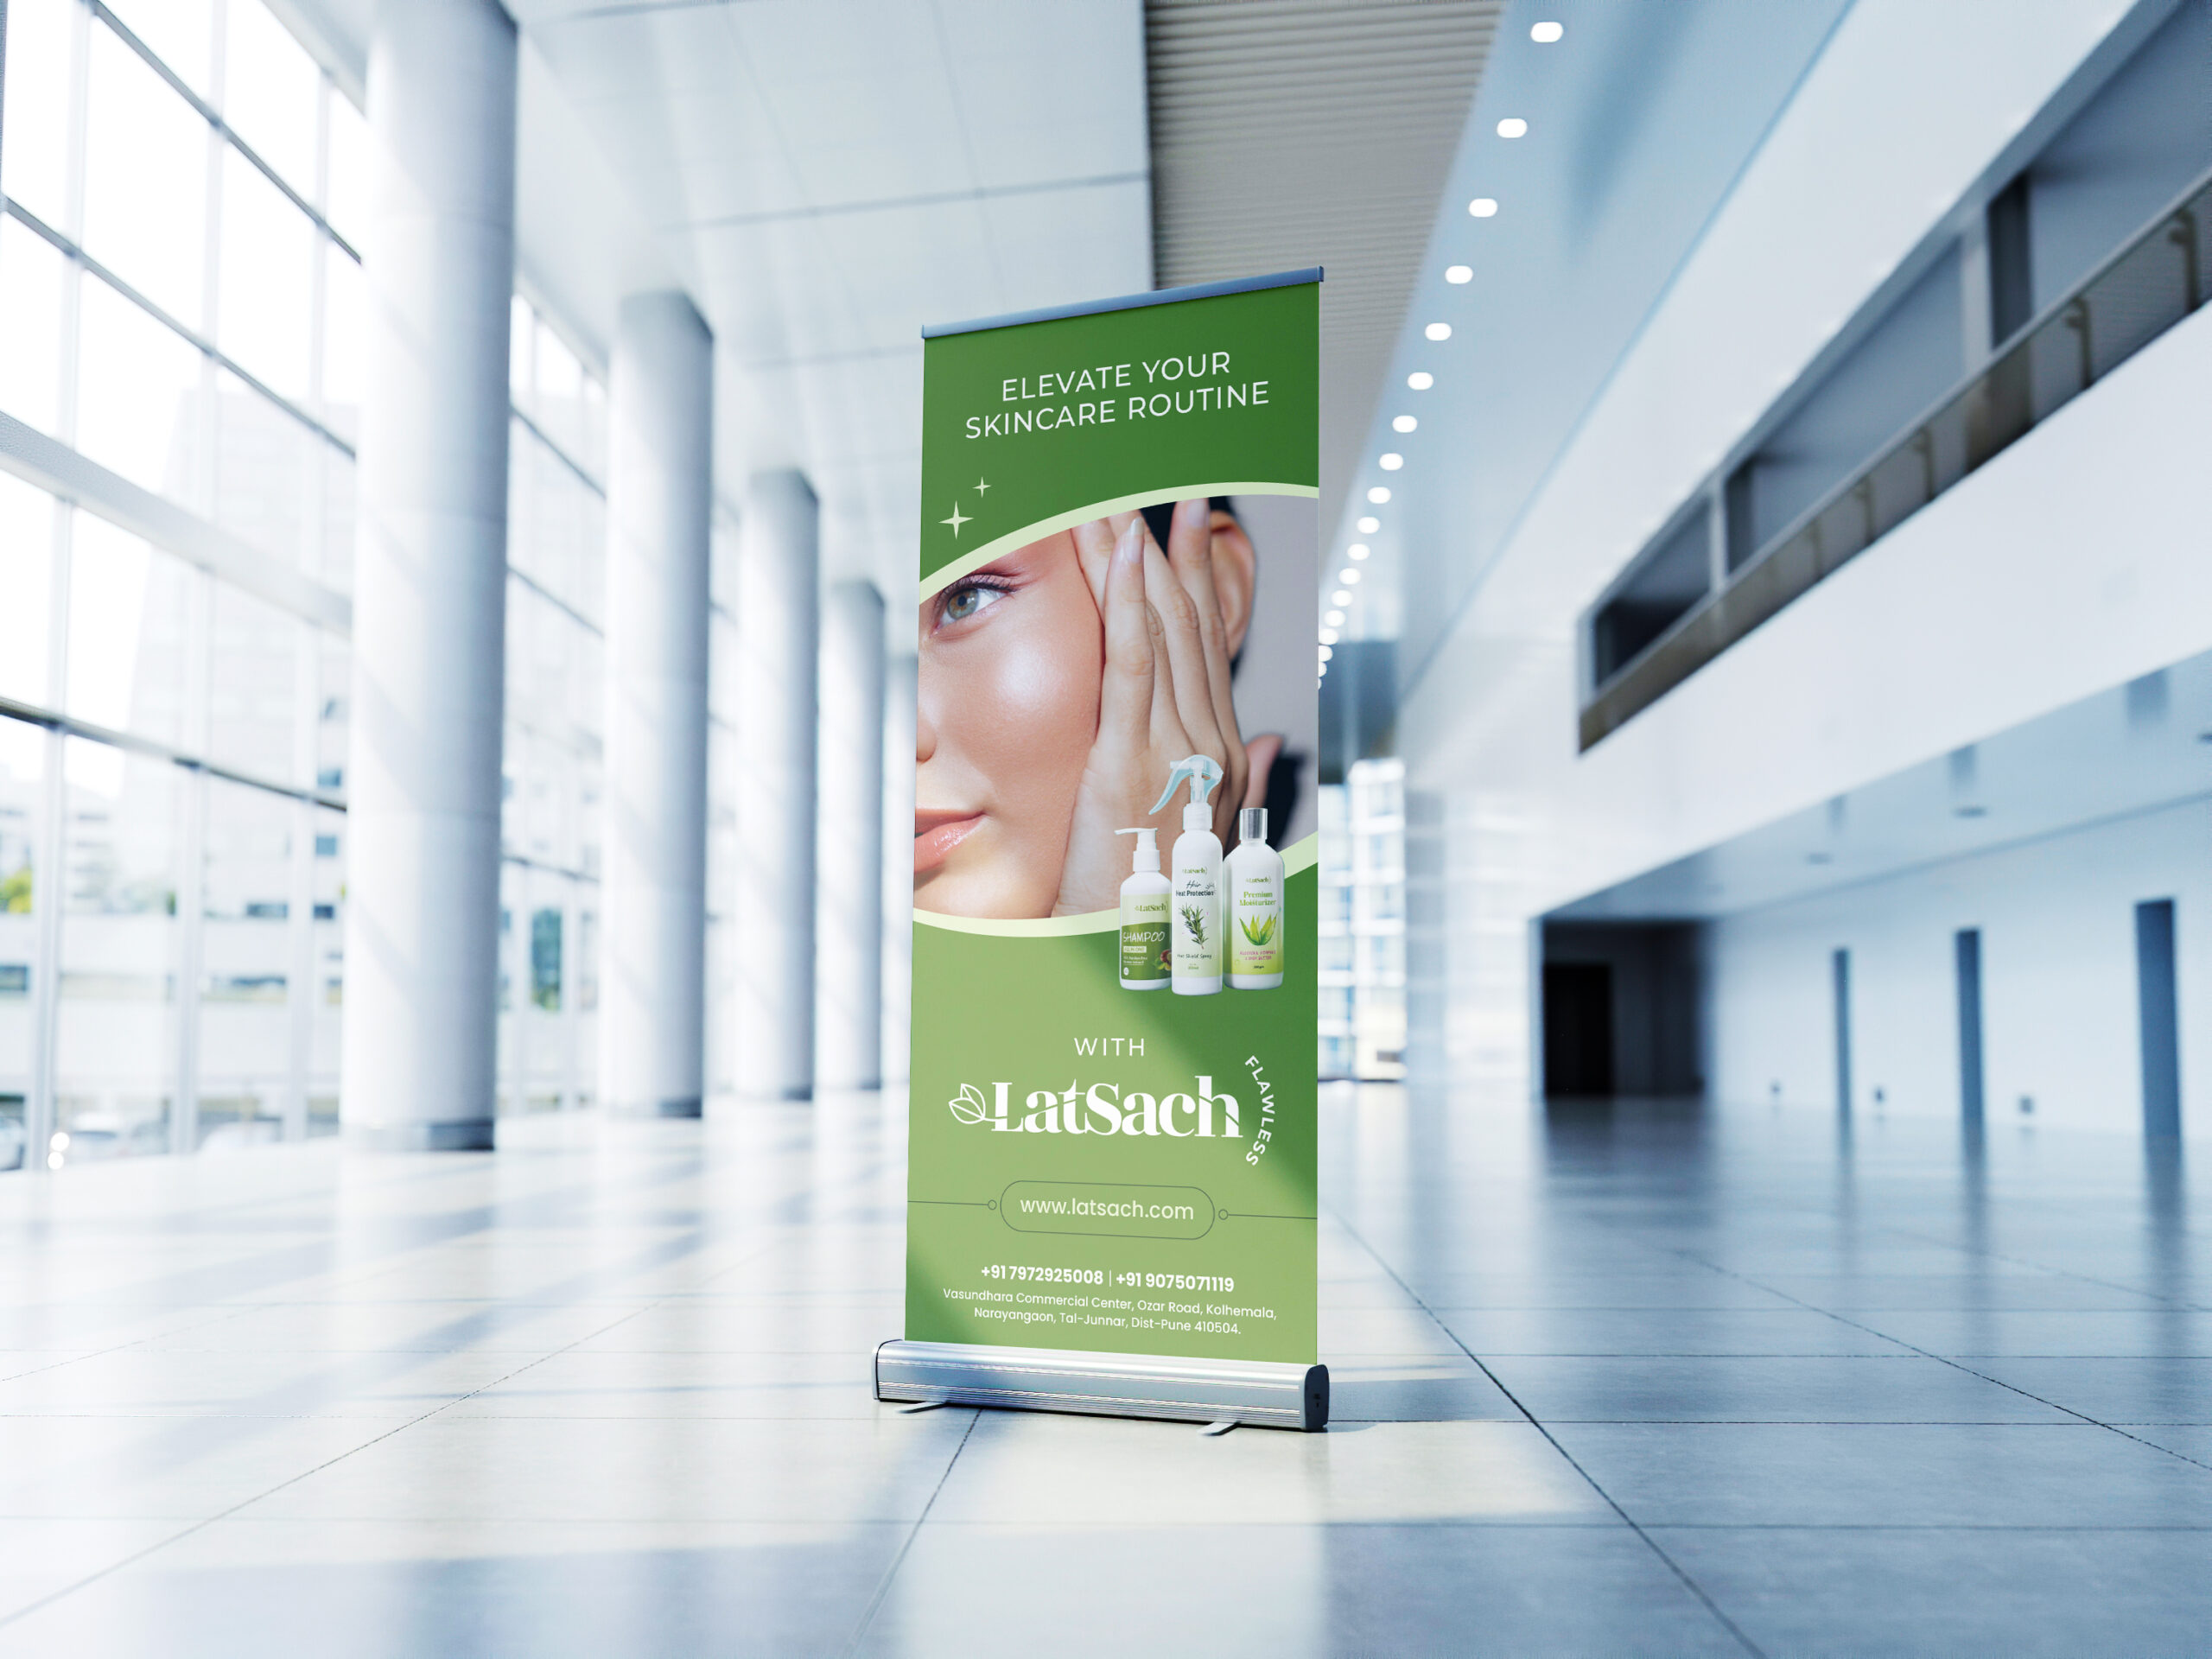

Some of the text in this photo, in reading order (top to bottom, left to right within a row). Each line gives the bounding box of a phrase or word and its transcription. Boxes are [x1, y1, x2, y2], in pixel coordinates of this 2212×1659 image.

[1002, 351, 1230, 402] ELEVATE YOUR
[965, 380, 1269, 440] SKINCARE ROUTINE
[1123, 931, 1166, 943] SHAMPOO
[1074, 1037, 1145, 1057] WITH
[991, 1075, 1244, 1139] LatSach
[1244, 1055, 1275, 1166] FLAWLESS
[1020, 1197, 1194, 1221] www.latsach.com
[981, 1264, 1235, 1293] +91 7972925008 +91 9075071119
[943, 1287, 1277, 1321] Vasundhara Commercial Center, Ozar Road, Kolhemala,
[974, 1306, 1242, 1335] Narayangaon, Tal-Junnar, Dist-Pune 410504.
